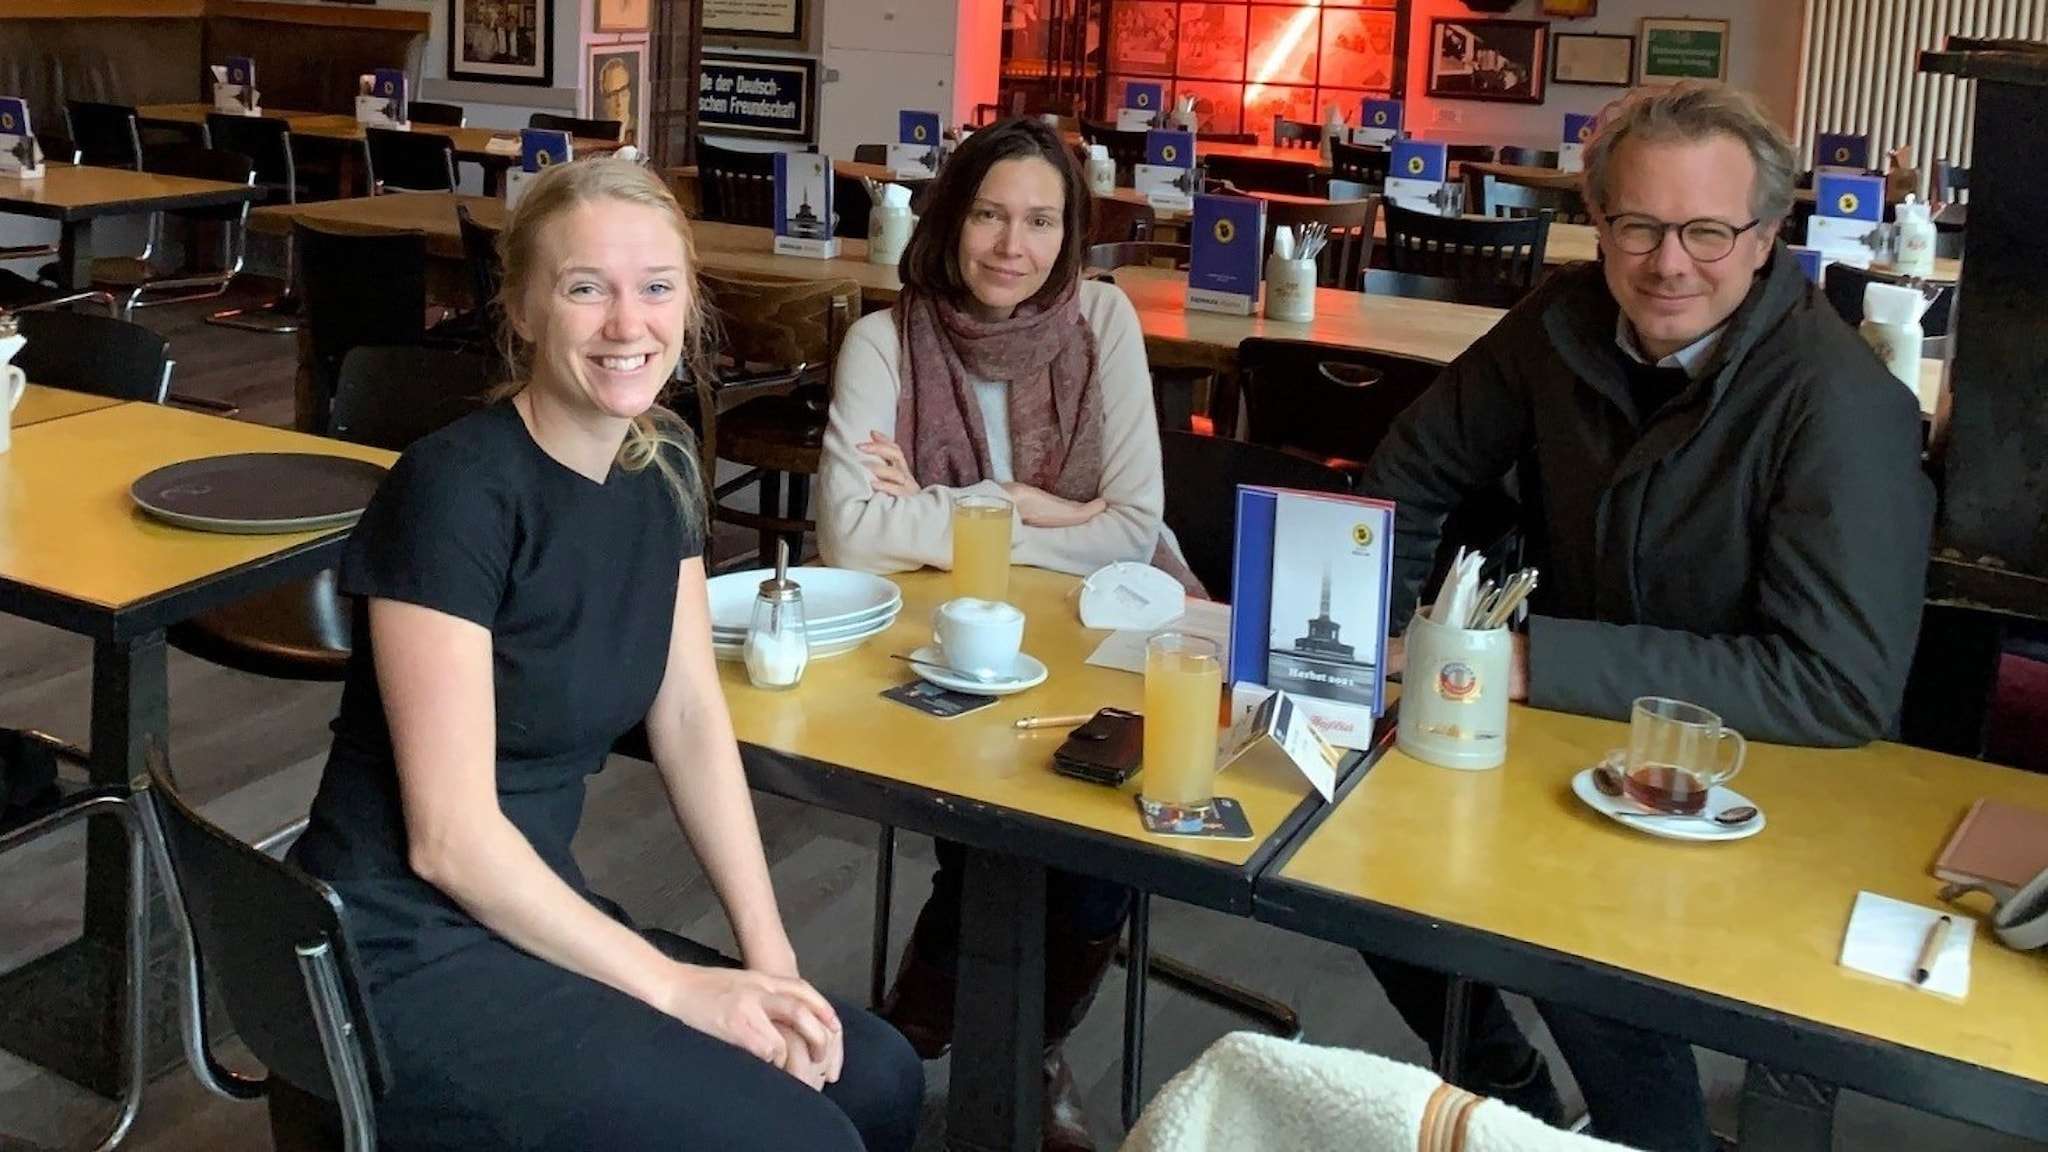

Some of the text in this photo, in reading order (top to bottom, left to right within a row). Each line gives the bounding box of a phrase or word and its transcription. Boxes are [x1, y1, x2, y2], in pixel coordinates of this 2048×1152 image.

[715, 74, 734, 92] der
[736, 75, 782, 95] Deutsch-
[730, 96, 796, 119] Freundschaft
[1288, 668, 1327, 682] Herbst
